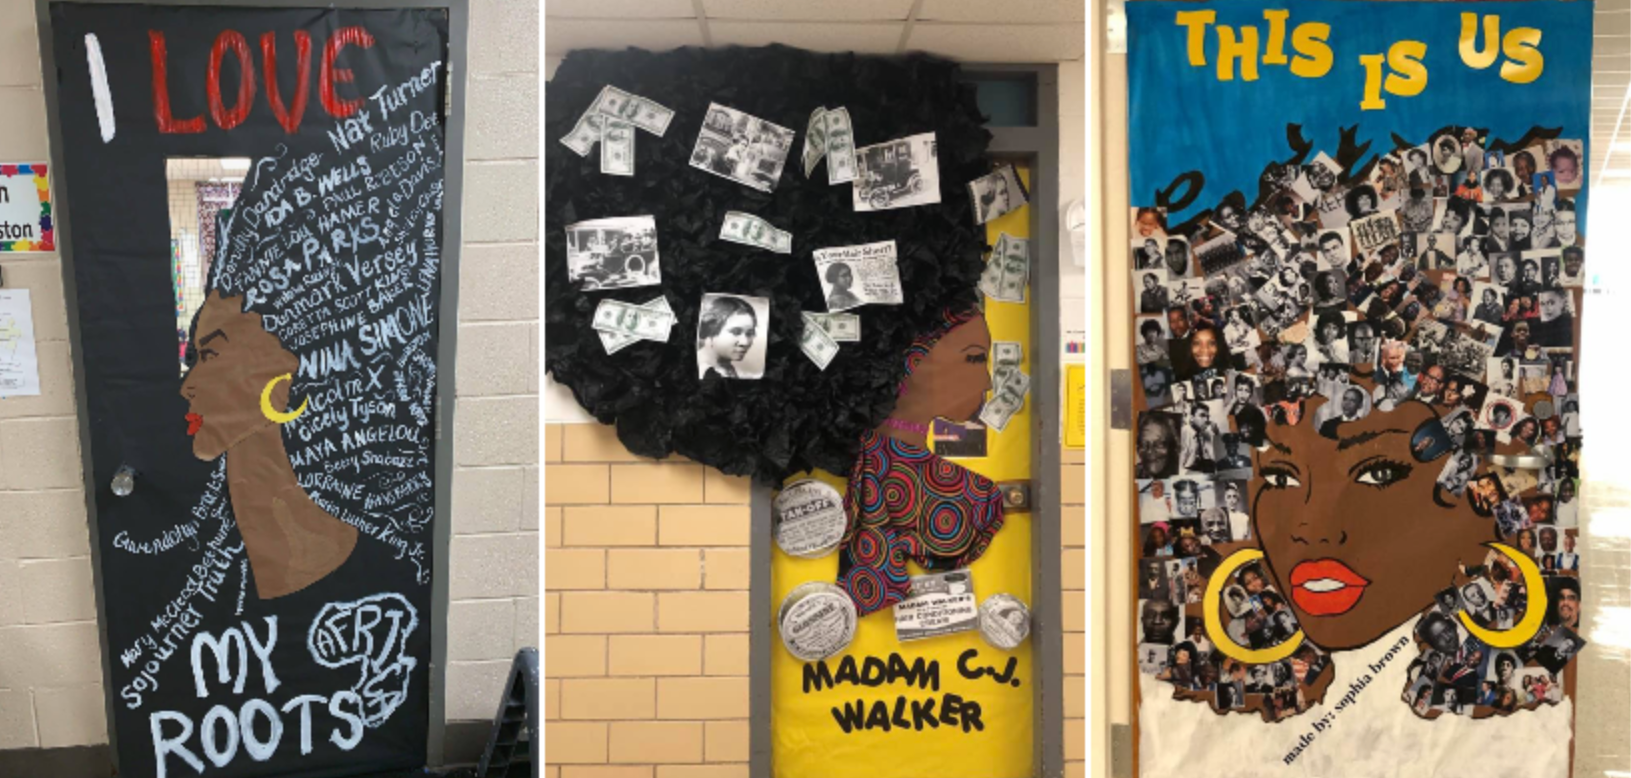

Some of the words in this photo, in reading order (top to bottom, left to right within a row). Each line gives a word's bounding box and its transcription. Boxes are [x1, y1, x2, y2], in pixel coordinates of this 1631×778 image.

[85, 32, 115, 142] I
[148, 26, 375, 134] LOVE
[1175, 9, 1334, 82] THIS
[1358, 39, 1428, 111] IS
[1457, 11, 1544, 84] US
[326, 109, 373, 155] Nat
[369, 60, 442, 120] Turner
[370, 124, 409, 154] Ruby
[265, 199, 294, 229] IDA
[318, 155, 371, 198] WELLS
[317, 196, 380, 236] HAMER
[243, 258, 302, 313] ROSA
[302, 216, 380, 272] PARKS
[344, 239, 418, 286] Versey
[334, 286, 371, 313] SCOTT
[288, 311, 366, 351] JOSEPHINE
[298, 339, 362, 380] NINA
[359, 292, 434, 356] SIMONE
[364, 364, 386, 391] X
[349, 396, 396, 424] Tyson
[290, 437, 338, 470] MAYA
[341, 424, 420, 453] ANGELOU
[341, 508, 380, 536] Luther
[376, 522, 408, 560] King
[120, 602, 204, 710] Sojourner
[195, 541, 245, 602] Truth
[190, 614, 281, 698] MY
[802, 652, 940, 694] MADAM
[956, 648, 1021, 688] C.J.
[830, 693, 985, 734] WALKER
[1282, 731, 1316, 766] made
[1334, 674, 1374, 713] sophia
[1368, 635, 1410, 674] brown
[150, 690, 364, 778] ROOTS
